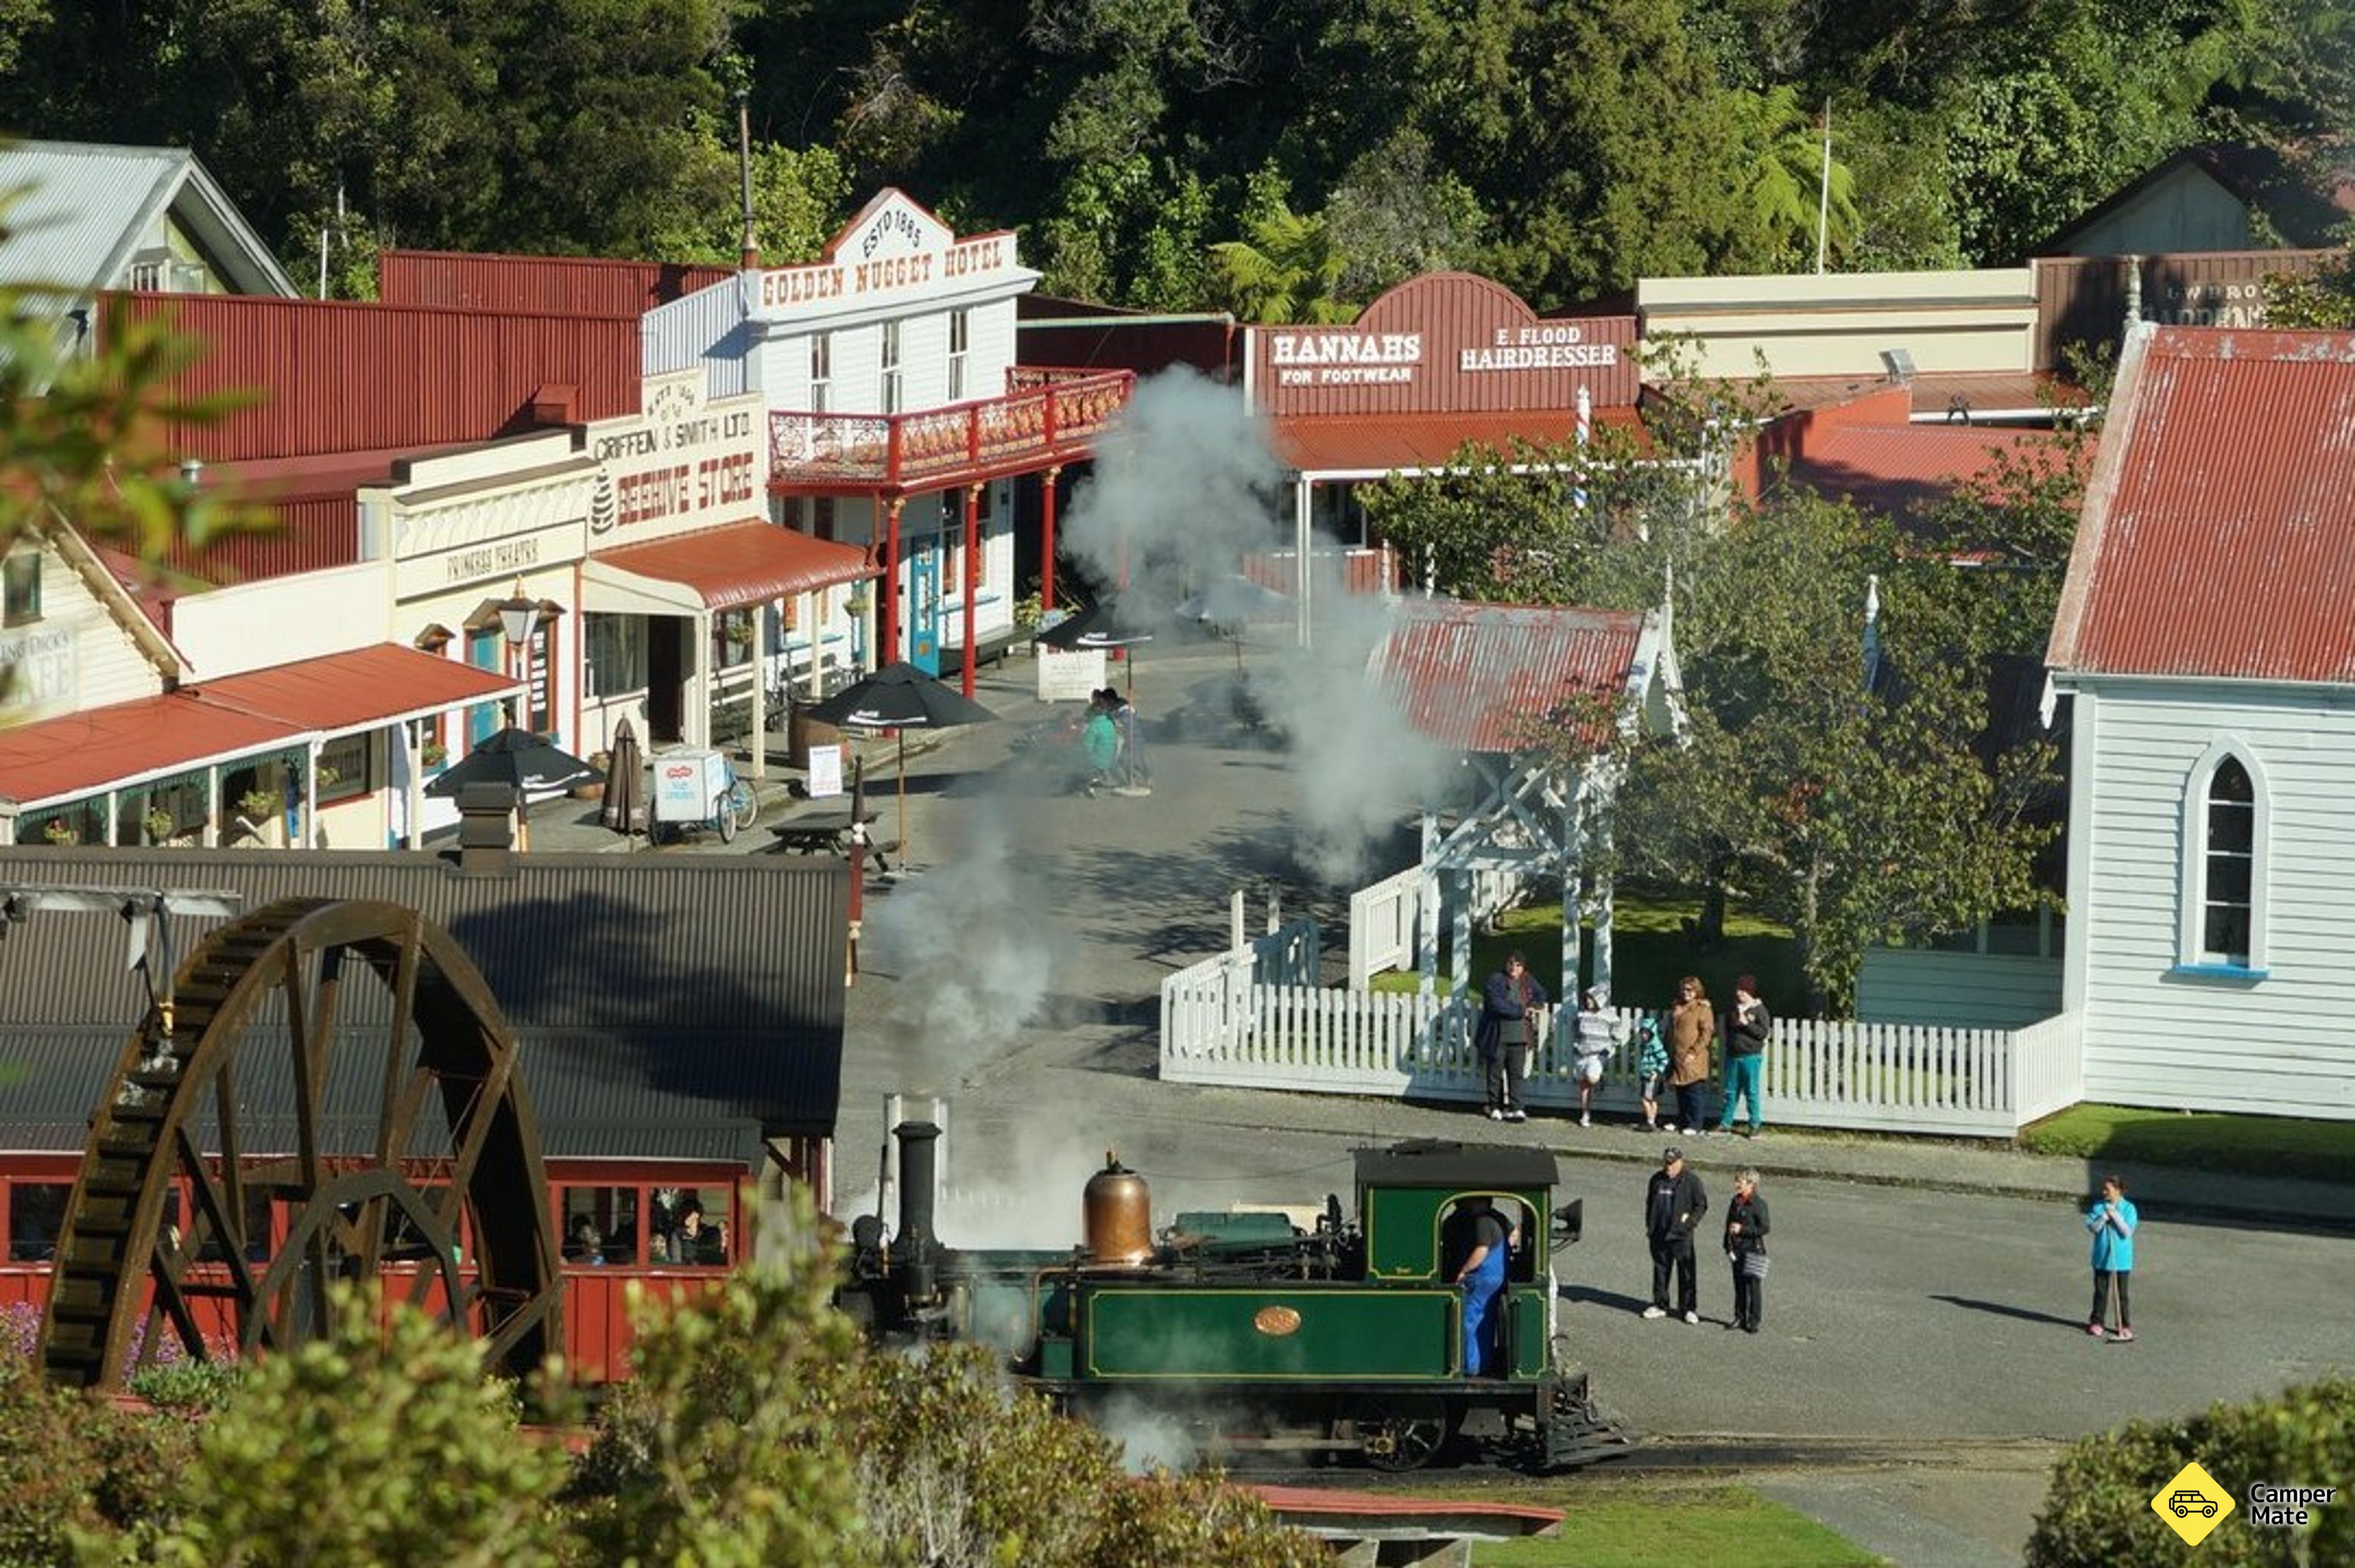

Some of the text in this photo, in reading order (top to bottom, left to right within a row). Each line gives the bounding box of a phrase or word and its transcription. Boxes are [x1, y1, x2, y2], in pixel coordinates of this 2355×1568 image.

[863, 210, 892, 258] ESTD
[763, 241, 1001, 306] GOLDEN NUGGET HOTEL
[1273, 334, 1421, 364] HANNAHS
[1497, 327, 1581, 345] E. FLOOD
[1460, 344, 1617, 370] HAIRDRESSER
[1281, 367, 1411, 384] FOR FOOTWEAR
[676, 417, 719, 448] SMITH
[618, 451, 754, 526] BEEHIVE STORE
